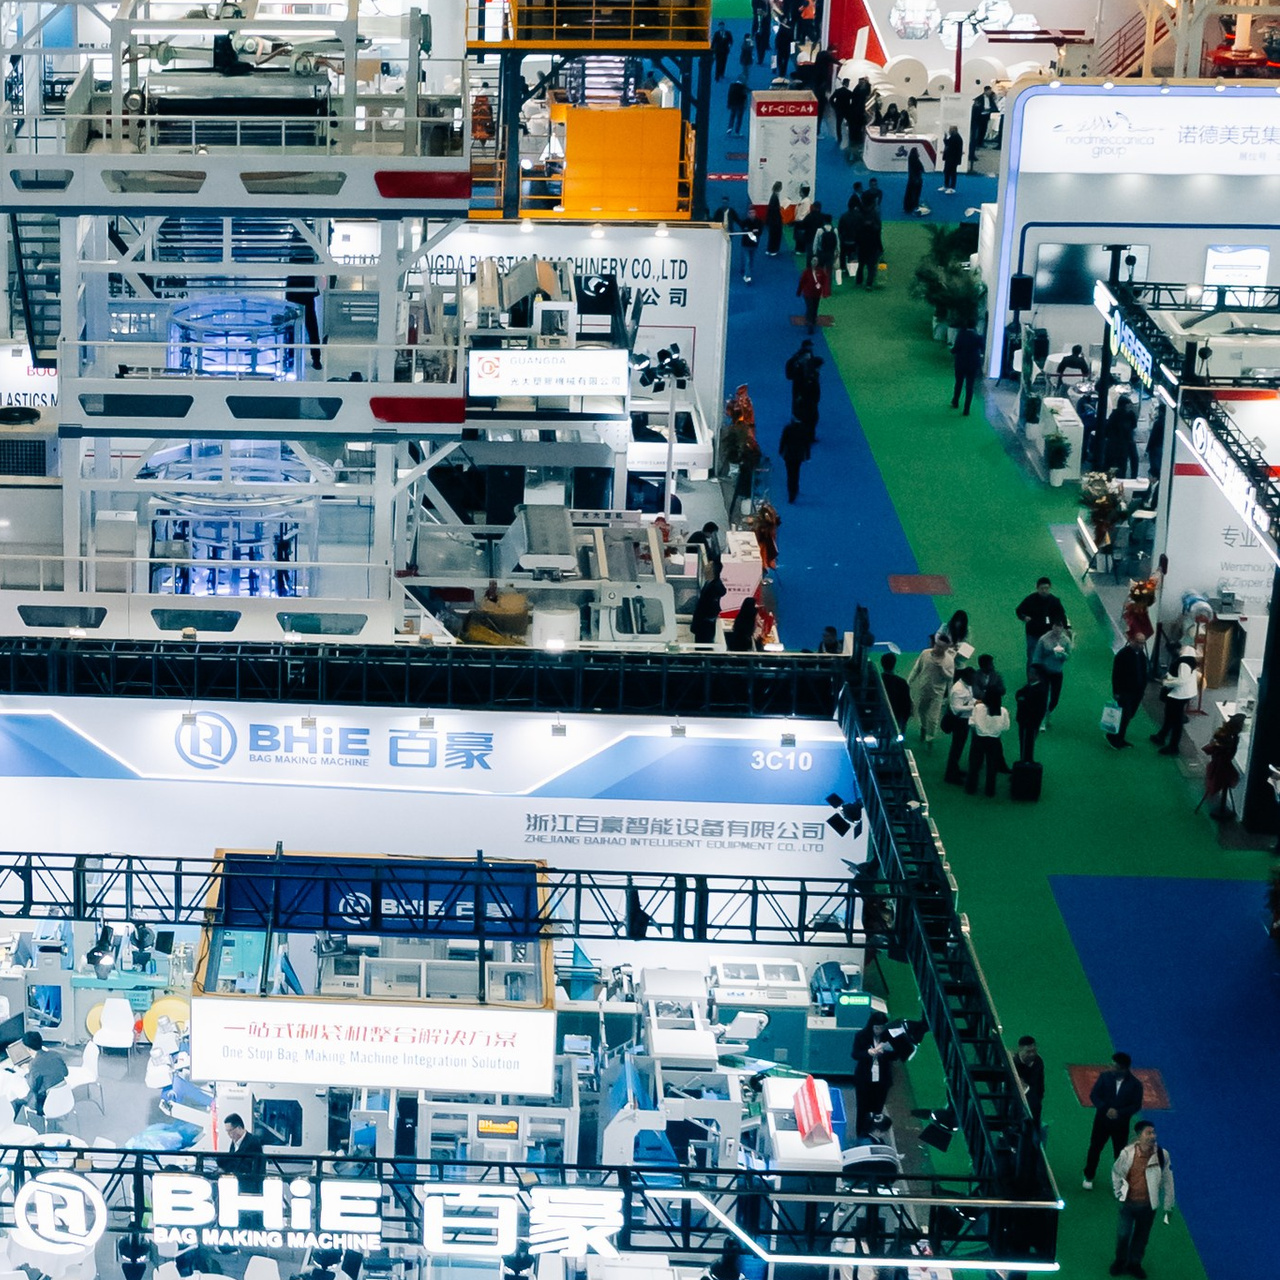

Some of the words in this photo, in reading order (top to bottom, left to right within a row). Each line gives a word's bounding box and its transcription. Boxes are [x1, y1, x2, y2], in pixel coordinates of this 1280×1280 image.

[1065, 133, 1155, 145] nordmeccanica
[1178, 124, 1280, 145] 诺德美克集
[1091, 145, 1127, 159] group
[509, 356, 567, 366] GUANGDA
[1220, 561, 1266, 572] Wenzhou
[248, 753, 272, 763] BAG
[274, 754, 317, 765] MAKING
[320, 756, 369, 767] MACHINE
[388, 728, 494, 771] 百豪
[750, 750, 813, 771] 3C10
[525, 812, 826, 841] 浙江百豪智能设备有限公司
[524, 833, 580, 844] ZHEJIANG
[584, 835, 627, 846] BAIHAO
[630, 837, 701, 848] INTELLIGENT
[706, 839, 773, 851] EQUIPMENT
[223, 1021, 520, 1048] 一站式制袋机整合解决方案
[221, 1044, 244, 1059] One
[247, 1045, 273, 1062] Stop
[277, 1047, 299, 1064] Bag
[304, 1049, 346, 1065] Making
[350, 1049, 399, 1066] Machine
[402, 1052, 468, 1069] Integration
[472, 1055, 520, 1070] Solution
[422, 1181, 625, 1258] 百豪
[153, 1227, 197, 1245] BAG
[202, 1228, 284, 1248] MAKING
[287, 1231, 382, 1251] MACHINE
